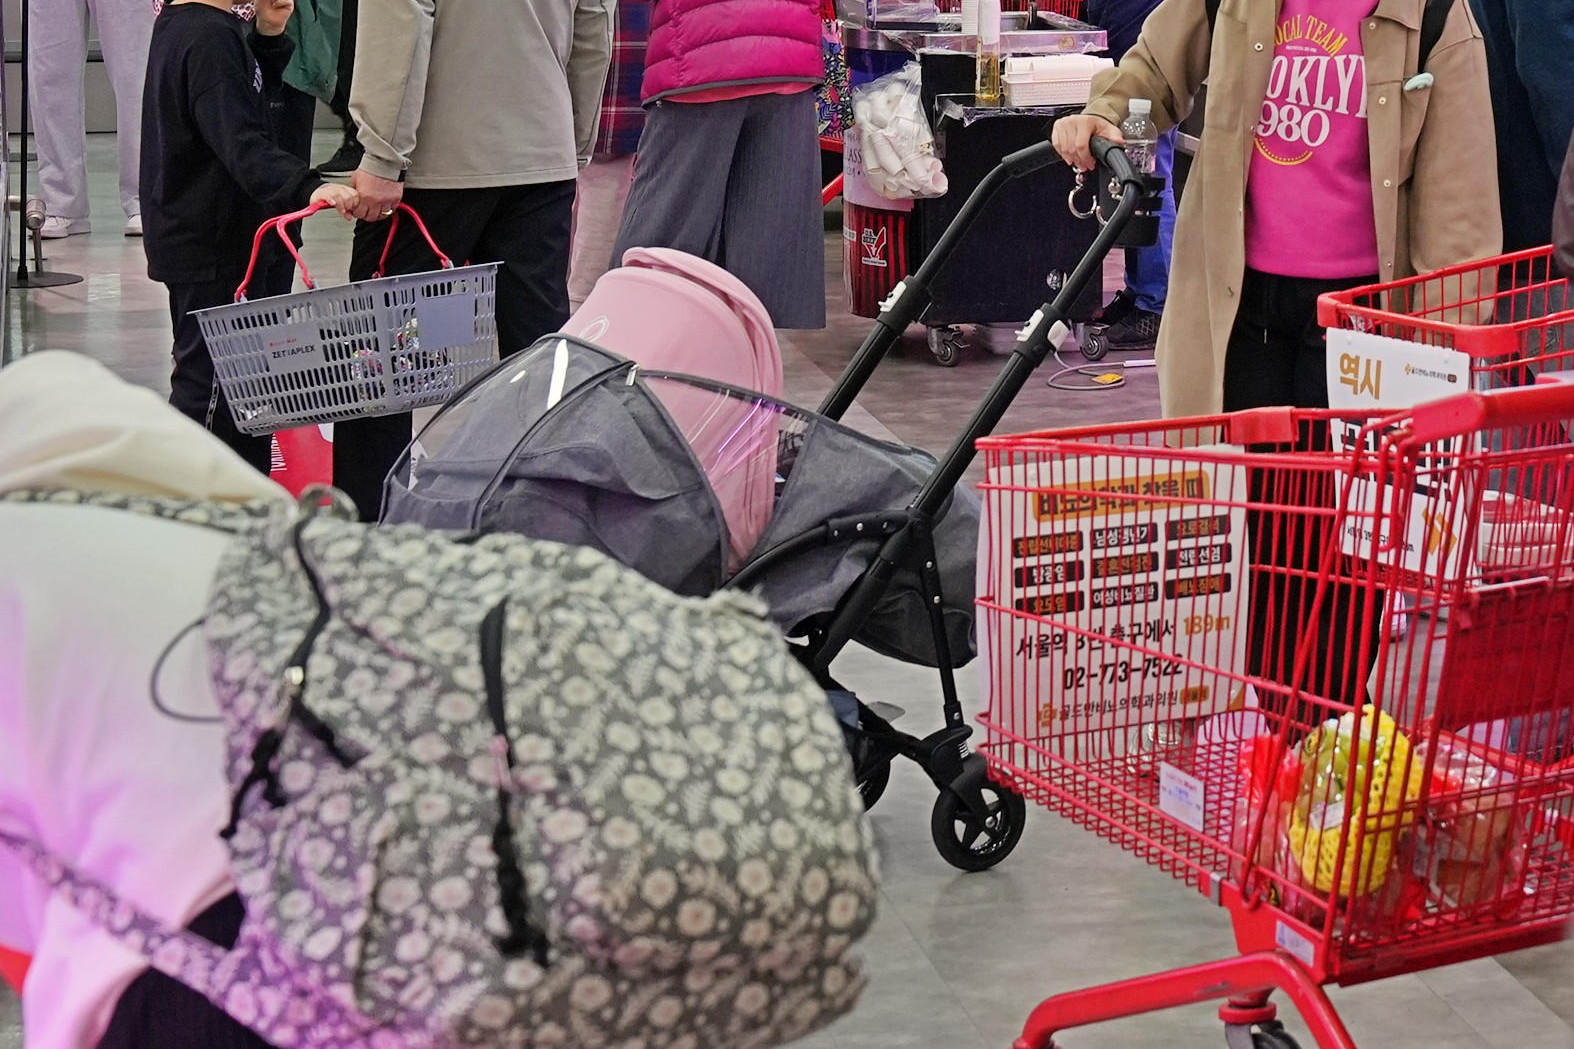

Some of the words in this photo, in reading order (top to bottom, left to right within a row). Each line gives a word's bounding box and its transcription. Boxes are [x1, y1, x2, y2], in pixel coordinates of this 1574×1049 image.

[1305, 14, 1348, 58] TEAM
[1257, 100, 1330, 148] 980
[1339, 352, 1382, 400] 역시
